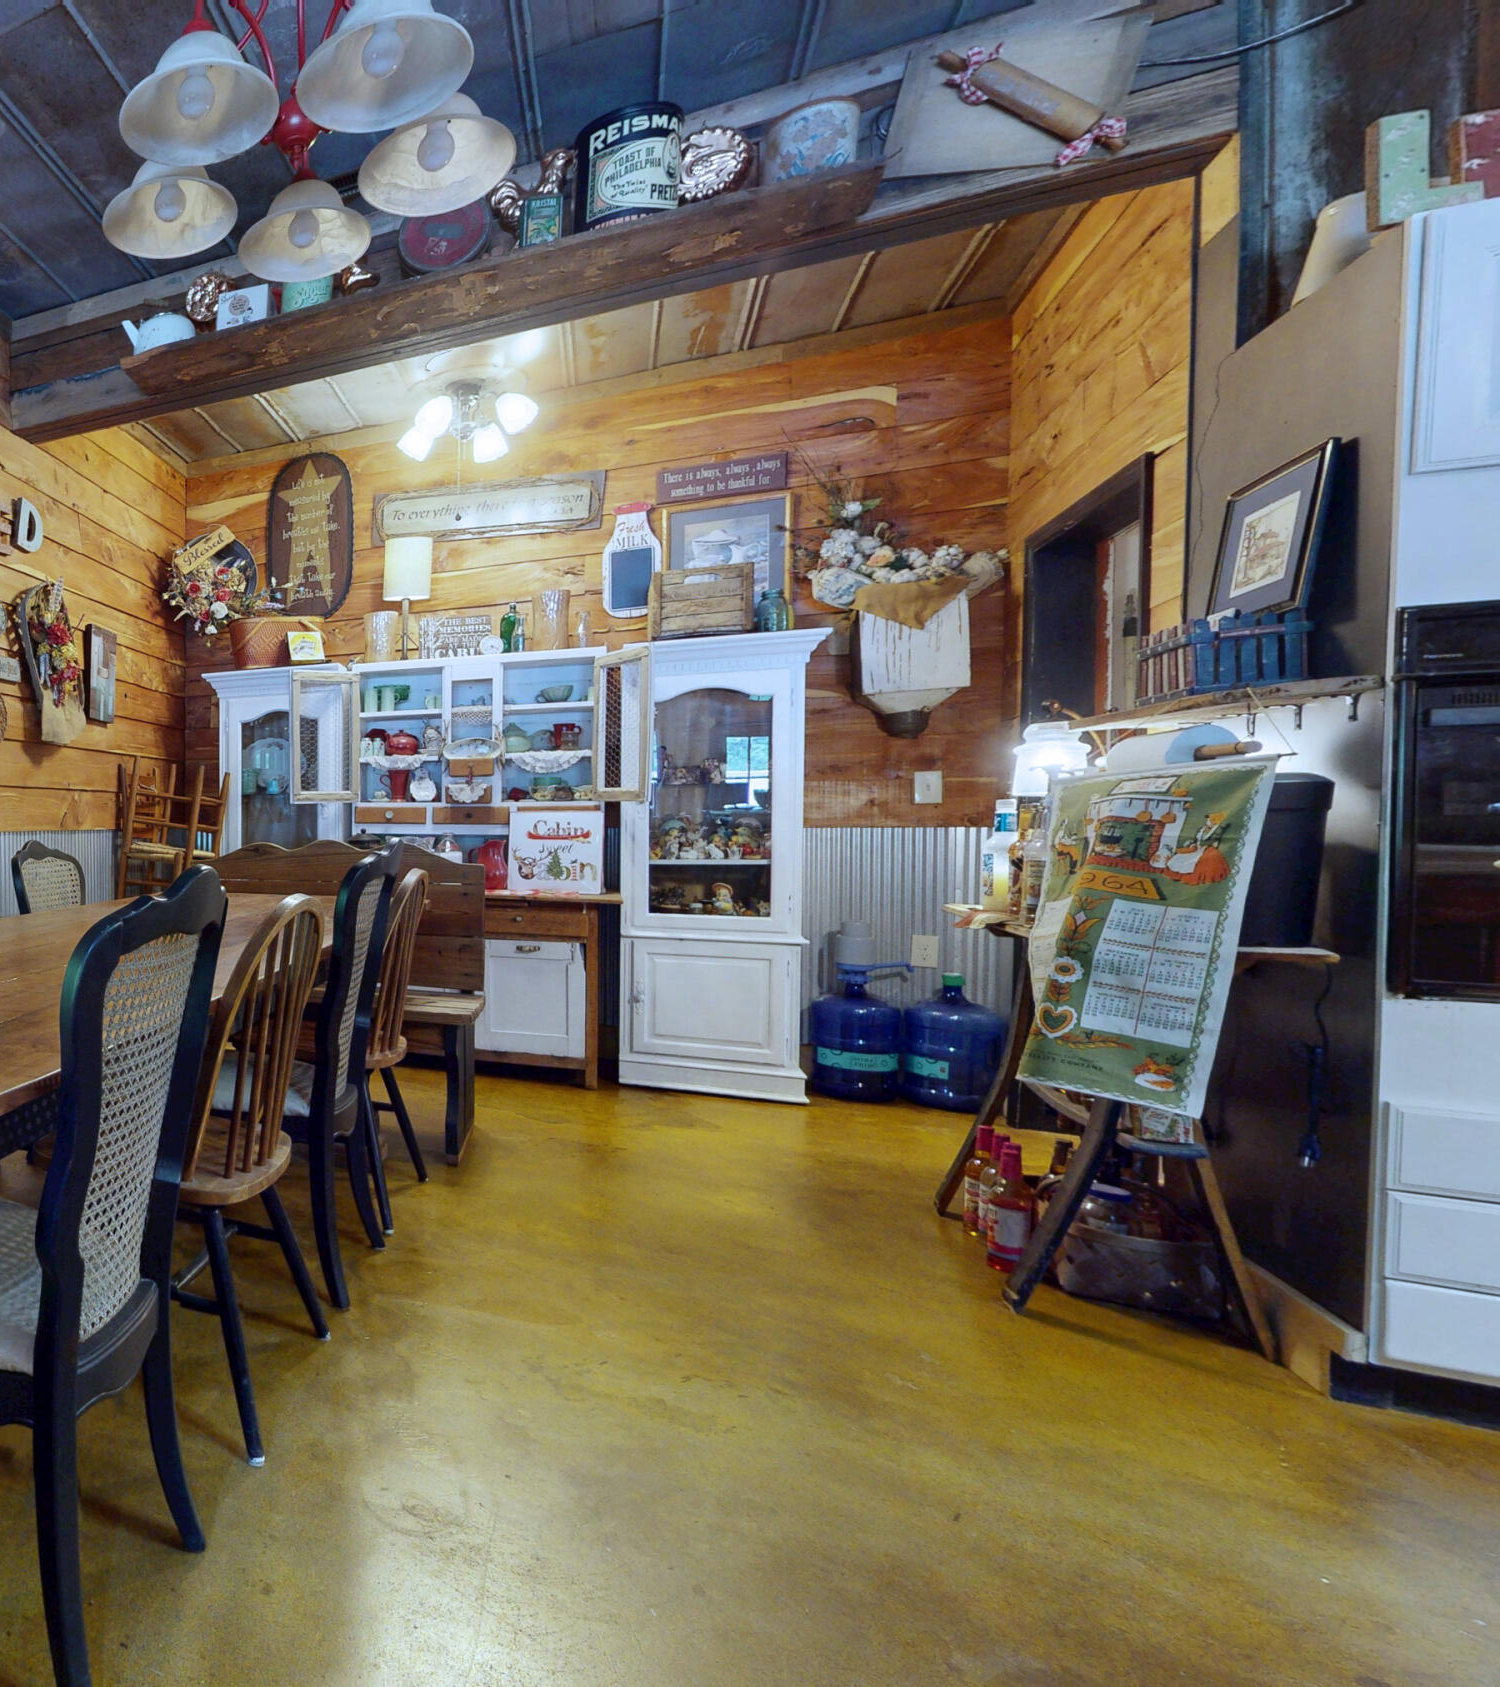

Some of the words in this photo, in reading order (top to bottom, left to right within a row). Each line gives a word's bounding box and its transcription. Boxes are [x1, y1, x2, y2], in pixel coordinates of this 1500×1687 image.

[589, 114, 683, 157] REISMA
[613, 148, 642, 170] TOAST
[645, 145, 656, 158] OF
[604, 157, 662, 188] PHILADELPHIA
[664, 472, 683, 484] There
[686, 470, 694, 481] is
[696, 466, 722, 480] always,
[725, 463, 749, 476] always
[670, 484, 705, 498] something
[707, 482, 714, 492] to
[717, 480, 725, 491] be
[727, 477, 756, 489] thankful
[758, 473, 770, 485] for
[321, 490, 331, 504] by
[392, 510, 406, 521] To
[616, 519, 646, 535] Fresh
[182, 531, 225, 566] Blessed
[616, 533, 649, 549] MILK
[444, 618, 462, 626] THE
[465, 616, 486, 625] BEST
[533, 819, 585, 837] Cabin
